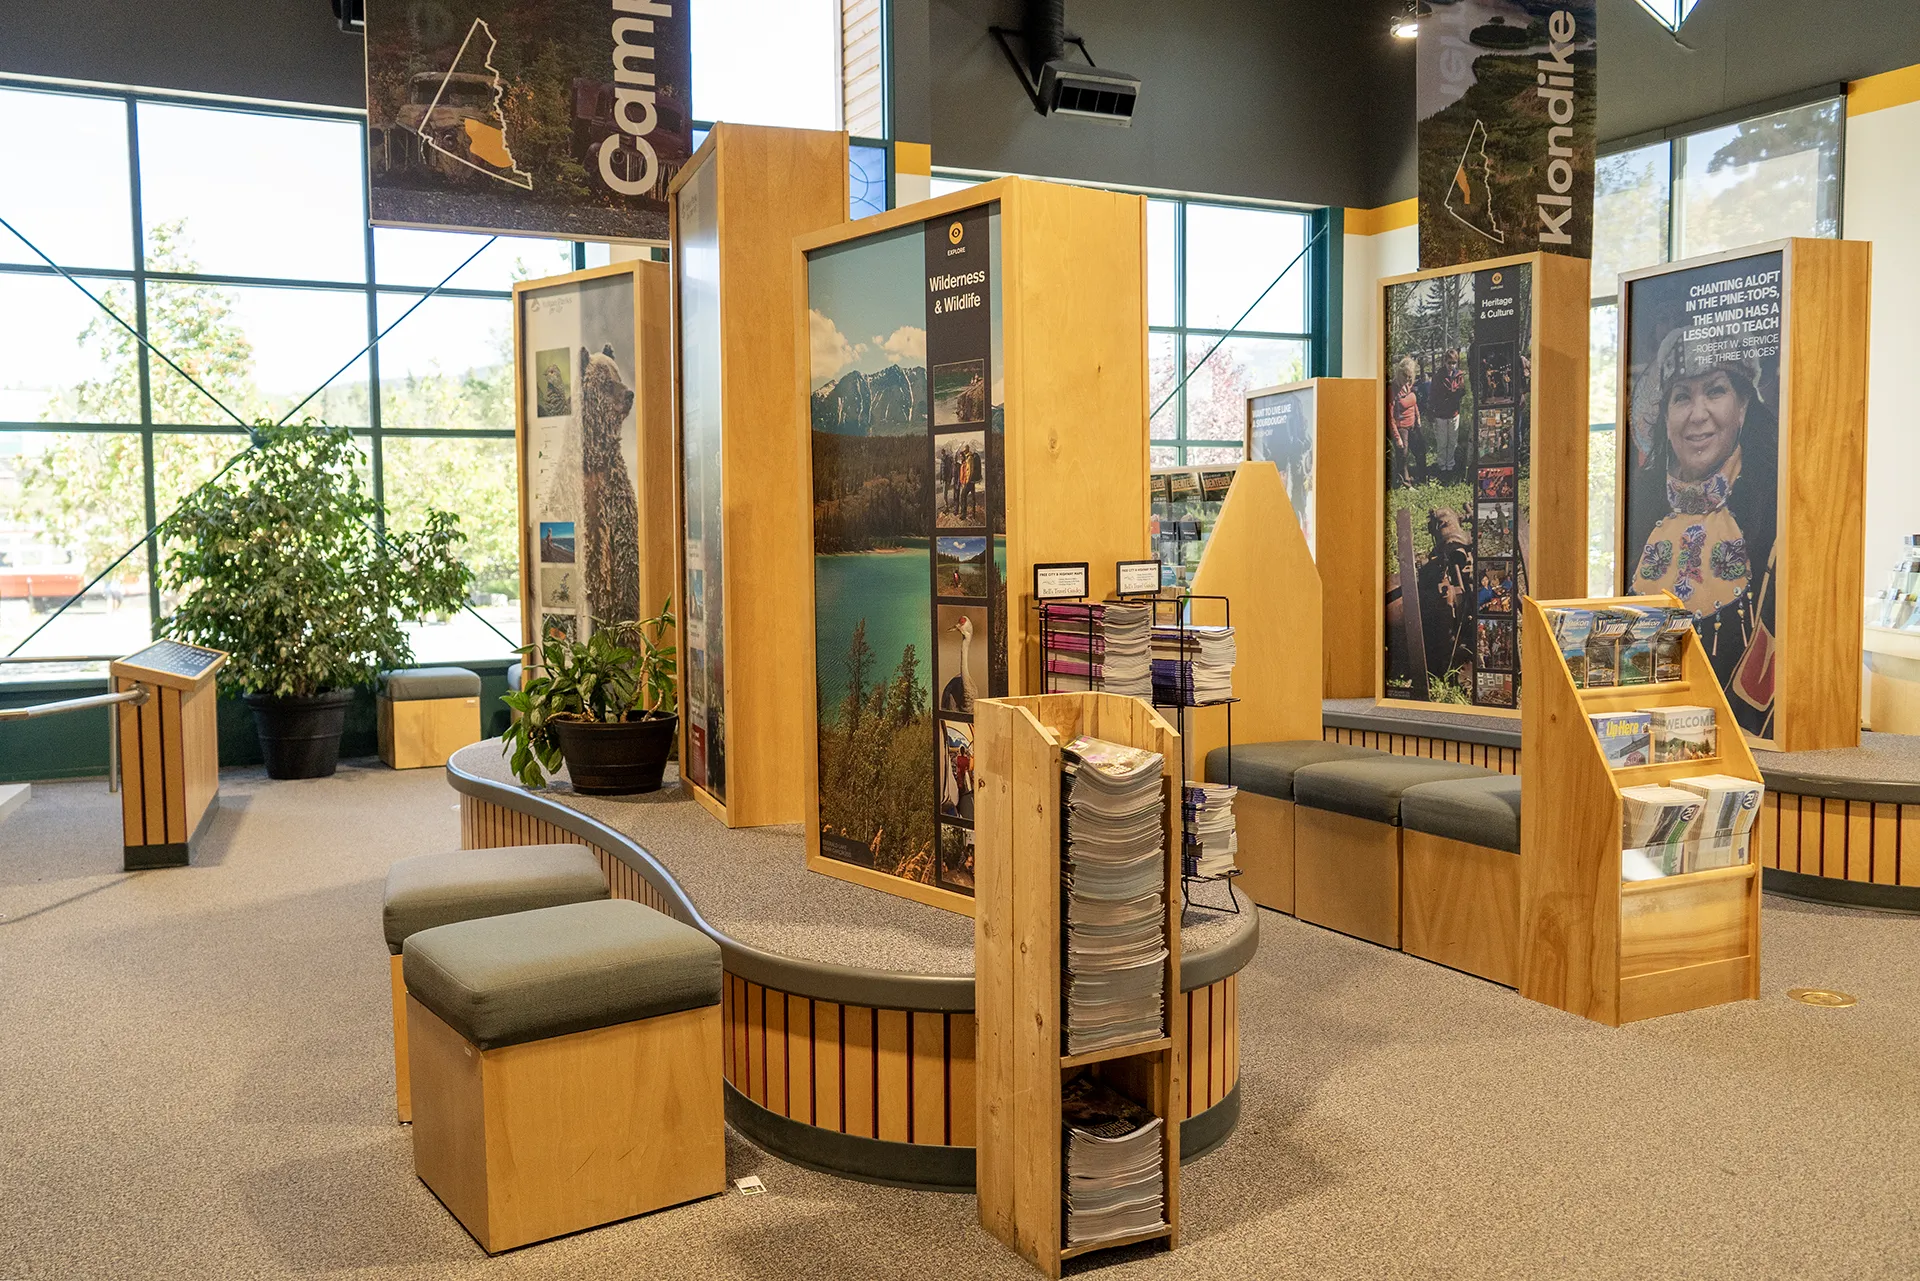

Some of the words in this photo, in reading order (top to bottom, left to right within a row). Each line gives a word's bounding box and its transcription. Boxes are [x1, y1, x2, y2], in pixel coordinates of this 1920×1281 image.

[1537, 10, 1576, 244] Klondike
[947, 247, 966, 256] EXPLORE
[929, 270, 986, 292] Wilderness
[1689, 277, 1743, 297] CHANTING
[1744, 270, 1780, 288] ALOFT
[934, 299, 943, 314] &
[943, 292, 981, 313] Wildlife
[1481, 297, 1513, 308] Heritage
[1685, 301, 1696, 312] IN
[1697, 296, 1718, 310] THE
[1719, 286, 1780, 306] PINE-TOPS,
[1480, 311, 1486, 319] &
[1487, 309, 1514, 318] Culture
[1692, 313, 1713, 326] THE
[1714, 308, 1744, 323] WIND
[1745, 303, 1769, 318] HAS
[1770, 302, 1780, 314] A
[1683, 325, 1724, 341] LESSON
[1725, 322, 1740, 335] TO
[1742, 316, 1779, 333] TEACH
[1729, 339, 1741, 349] W.
[1742, 333, 1779, 348] SERVICE
[1714, 350, 1741, 363] THREE
[1618, 719, 1639, 736] Here
[1665, 714, 1715, 730] WELCOME
[1744, 793, 1754, 809] RV
[1683, 807, 1695, 820] RV
